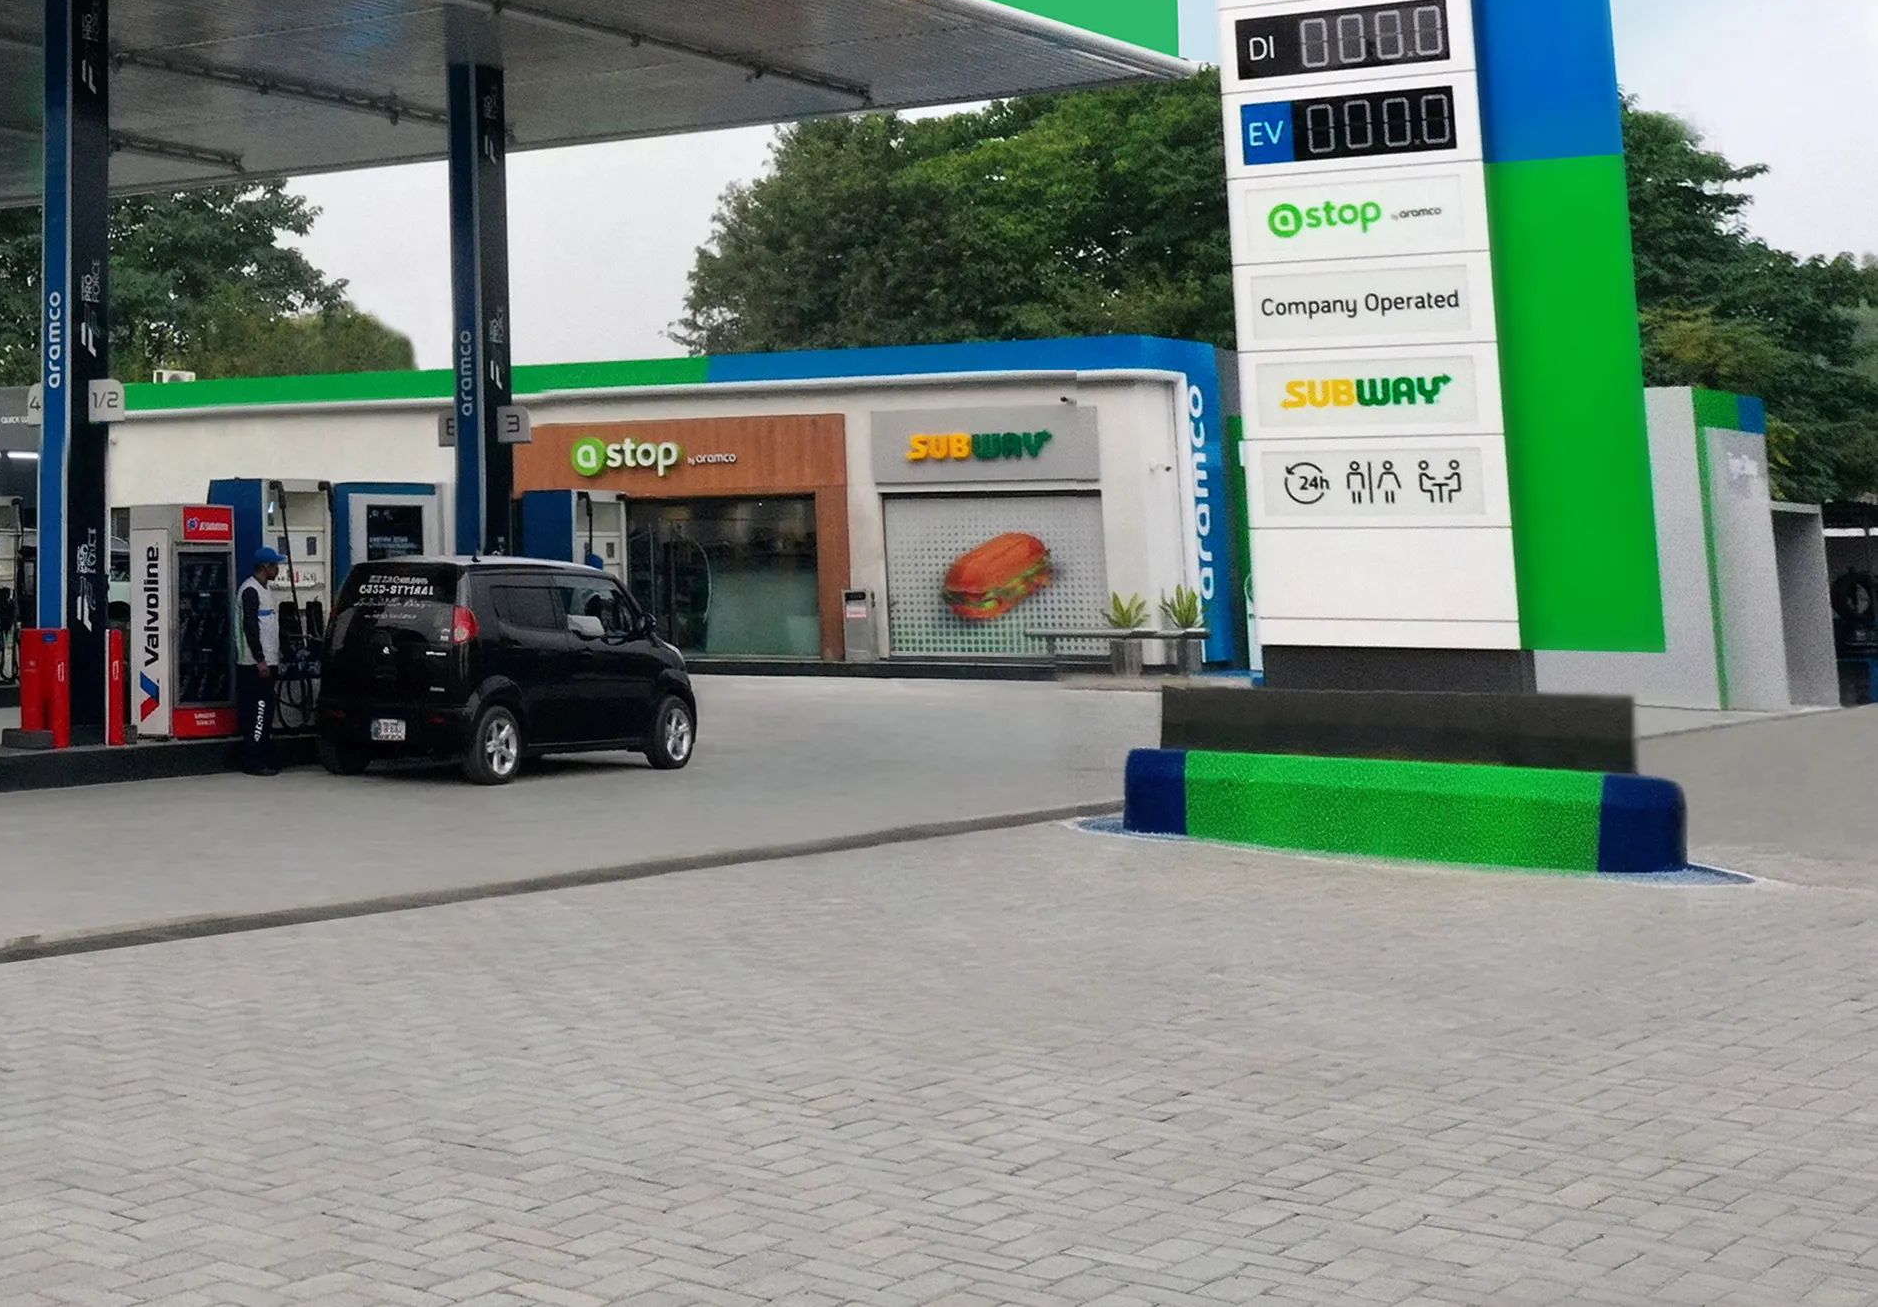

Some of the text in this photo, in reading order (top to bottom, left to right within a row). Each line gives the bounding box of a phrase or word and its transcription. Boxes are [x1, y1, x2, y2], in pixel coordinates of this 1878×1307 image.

[1248, 36, 1275, 61] DI
[1249, 120, 1284, 146] EV
[1399, 207, 1442, 219] aramco
[92, 259, 101, 303] FORCE
[1260, 290, 1460, 318] Company Operated
[48, 291, 62, 389] aramco
[460, 330, 473, 416] aramco
[29, 396, 41, 411] 4
[92, 391, 119, 408] 1/2
[1280, 374, 1453, 411] SUBWAY
[696, 453, 738, 464] aramco
[906, 429, 1054, 462] SUBWAY
[1188, 385, 1215, 600] aramco
[1299, 476, 1330, 491] 24h
[143, 546, 159, 667] Valvoline
